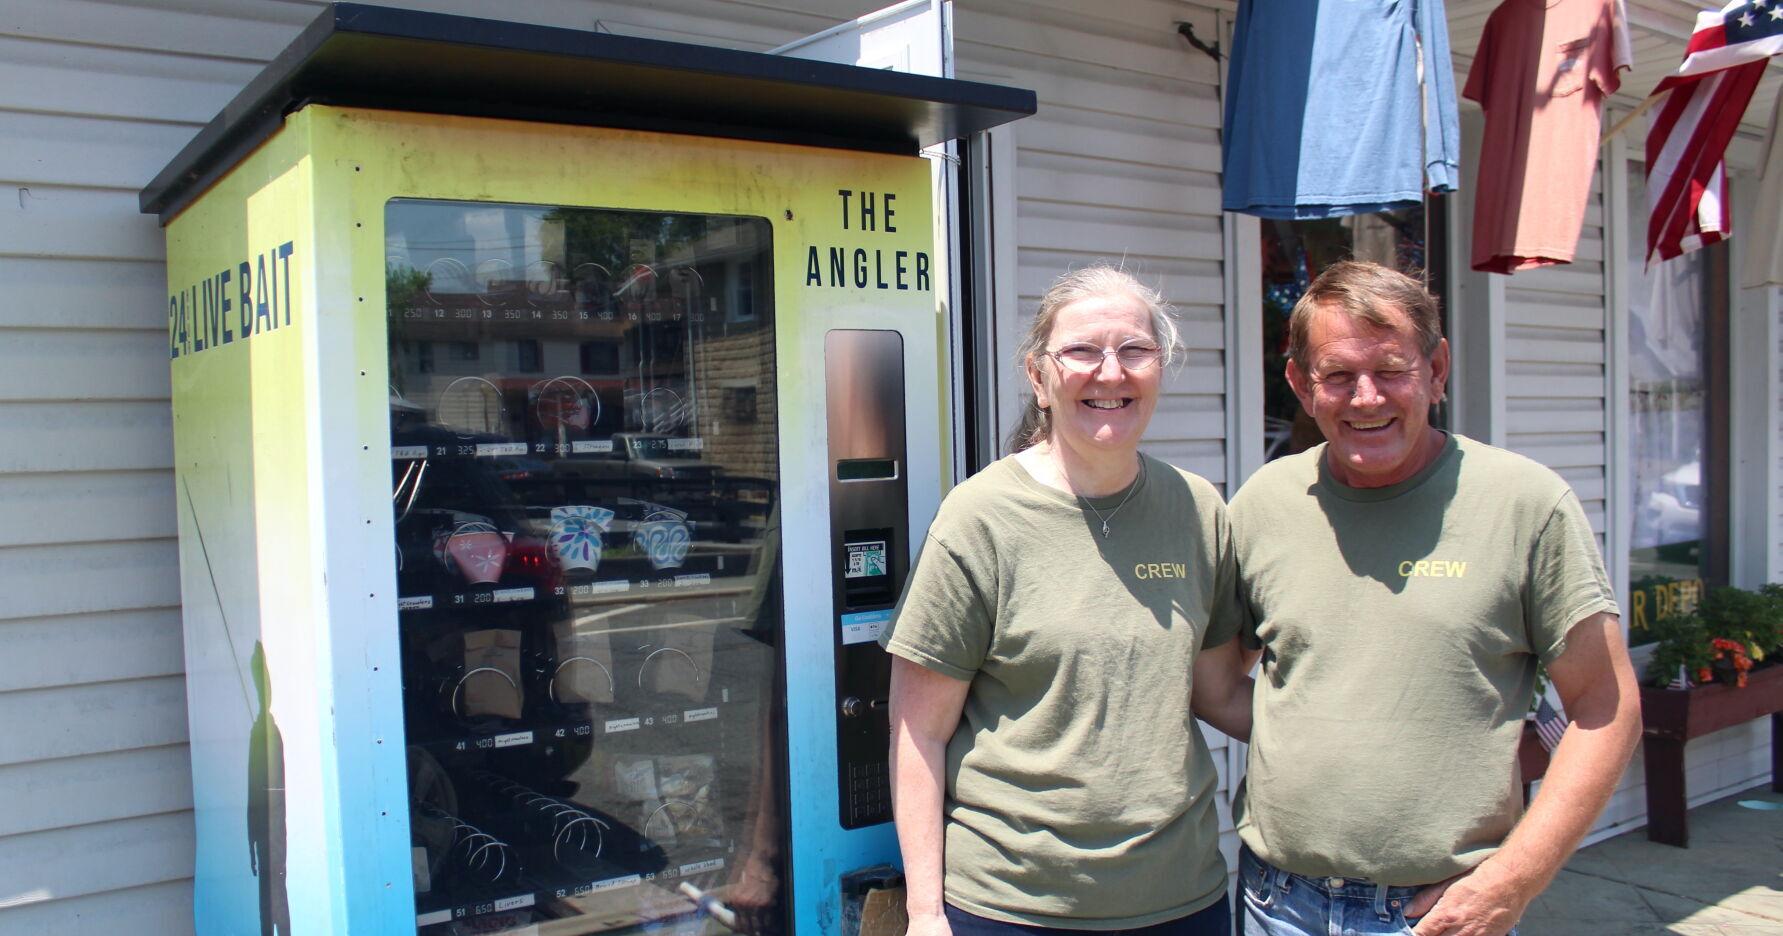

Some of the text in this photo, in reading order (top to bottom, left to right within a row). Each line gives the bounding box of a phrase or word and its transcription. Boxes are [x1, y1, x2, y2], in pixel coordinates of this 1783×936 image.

[838, 189, 897, 233] THE
[806, 246, 930, 291] ANGLER
[170, 291, 187, 359] 24
[192, 269, 233, 352] LIVE
[239, 240, 294, 339] BAIT
[434, 308, 473, 319] 12 300
[482, 309, 521, 319] 13 350
[531, 310, 568, 320] 14 350
[579, 311, 589, 320] 15
[628, 312, 638, 321] 16
[673, 313, 681, 321] 17
[535, 443, 546, 453] 22
[633, 440, 642, 449] 23
[436, 446, 446, 456] 21
[457, 445, 474, 456] 325
[1134, 562, 1187, 580] CREW
[1398, 560, 1466, 578] CREW
[640, 579, 649, 588] 33
[658, 578, 673, 588] 200
[554, 586, 564, 595] 32
[573, 585, 589, 595] 200
[454, 594, 464, 603] 31
[474, 593, 491, 603] 200
[644, 717, 654, 726] 43
[555, 725, 590, 737] 42 400
[456, 738, 493, 751] 41 400
[645, 873, 655, 881] 53
[556, 888, 566, 898] 52
[456, 908, 466, 917] 51
